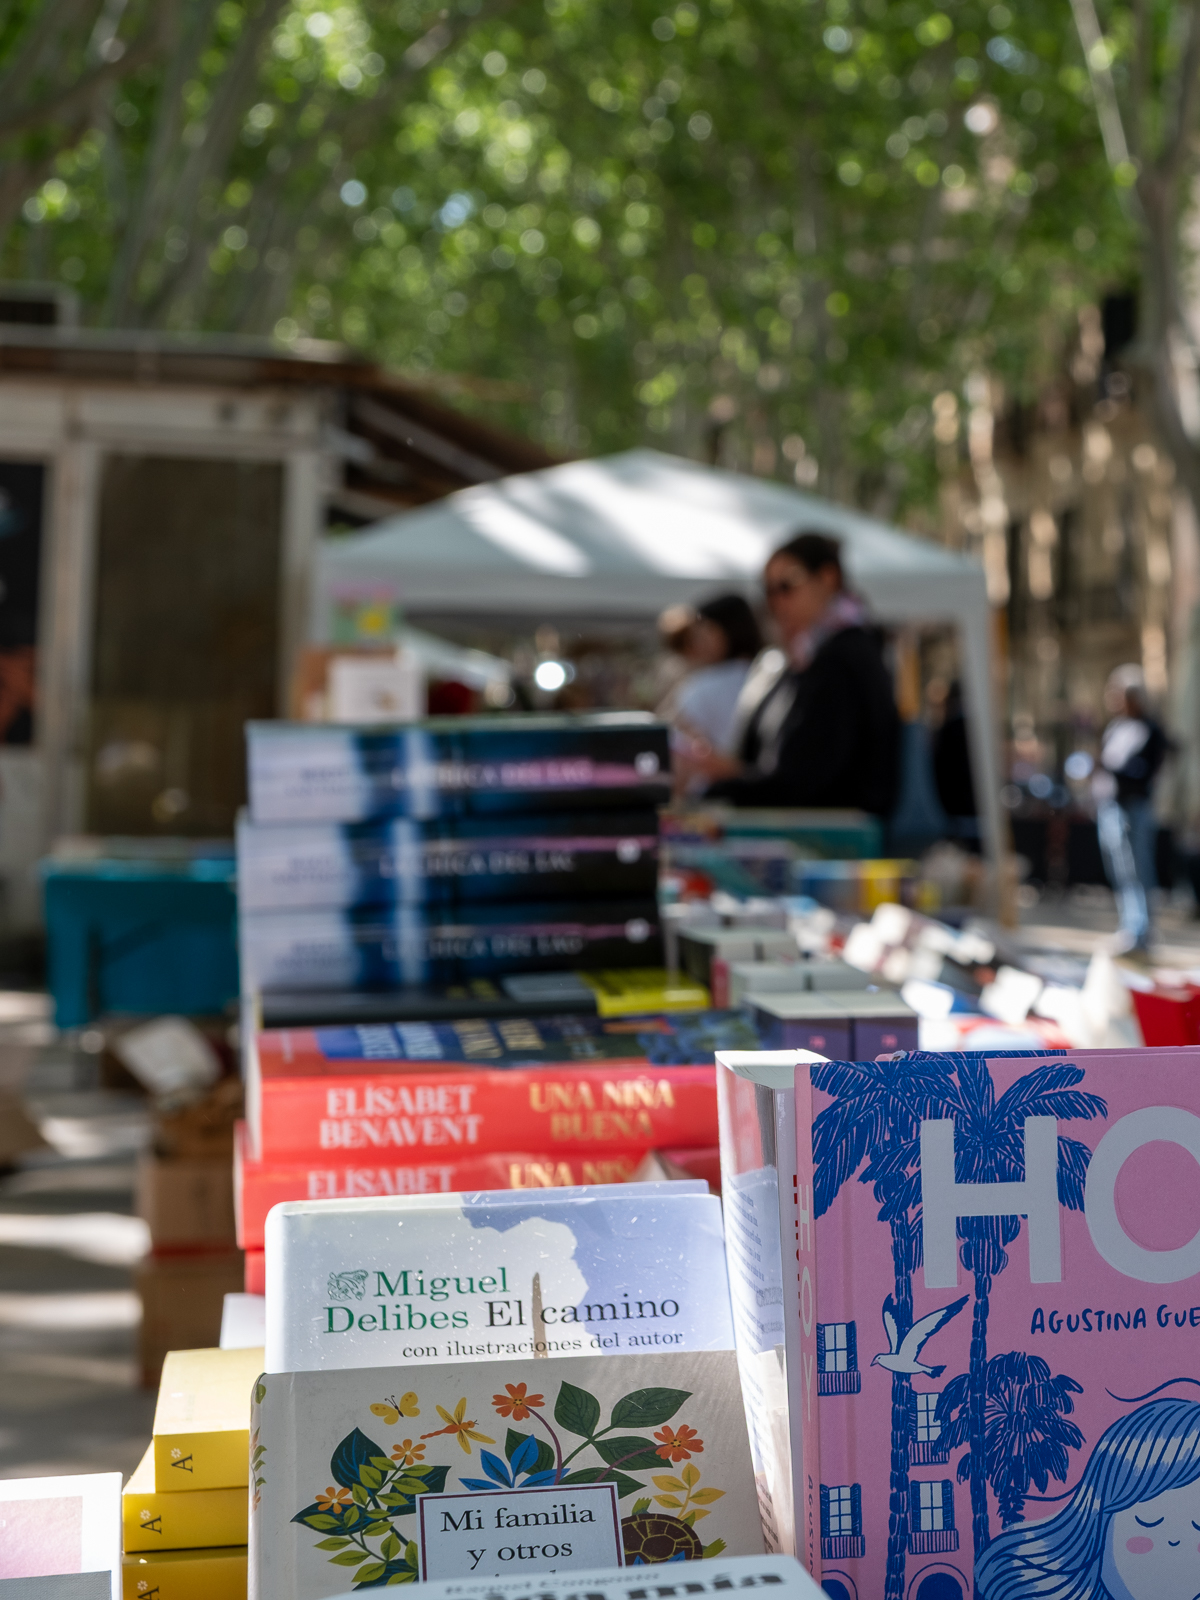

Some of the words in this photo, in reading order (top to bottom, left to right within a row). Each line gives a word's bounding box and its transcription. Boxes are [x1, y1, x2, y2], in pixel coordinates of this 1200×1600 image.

[529, 1080, 595, 1112] UNA
[602, 1074, 675, 1110] NIÑA
[319, 1114, 484, 1150] BENAVENT
[550, 1109, 656, 1142] BUENA
[372, 1266, 511, 1301] Miguel
[322, 1304, 470, 1335] Delibes
[484, 1299, 528, 1330] El
[539, 1292, 681, 1325] camino
[798, 1184, 814, 1422] HOY
[1030, 1307, 1147, 1335] AGUSTINA
[402, 1343, 439, 1359] con
[445, 1336, 583, 1358] ilustraciones
[590, 1331, 621, 1350] del
[628, 1328, 685, 1347] autor
[171, 1453, 194, 1474] A
[140, 1514, 163, 1536] A
[440, 1507, 485, 1533] Mi
[493, 1502, 596, 1530] familia
[466, 1546, 487, 1570] y
[497, 1537, 573, 1563] otros
